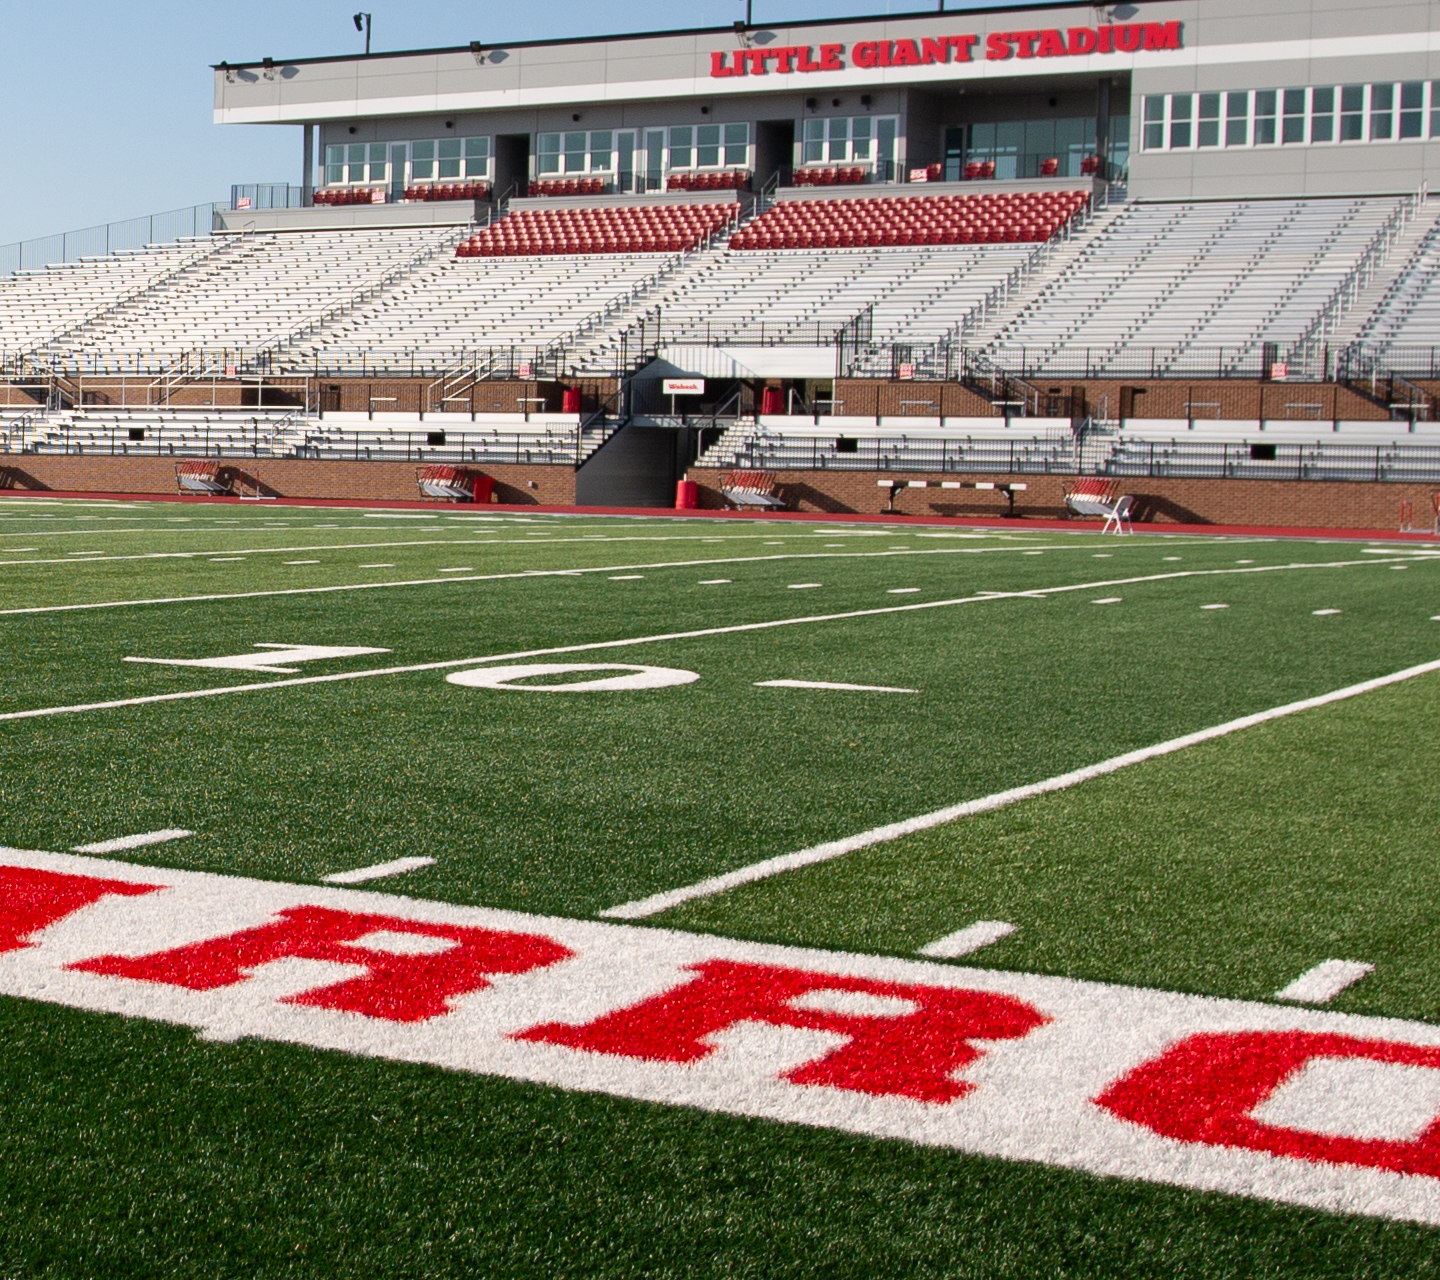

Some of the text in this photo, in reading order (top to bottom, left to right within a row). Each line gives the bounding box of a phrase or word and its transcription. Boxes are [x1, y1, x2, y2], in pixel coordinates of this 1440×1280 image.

[710, 20, 1181, 78] LITTLE GIANT STADIUM
